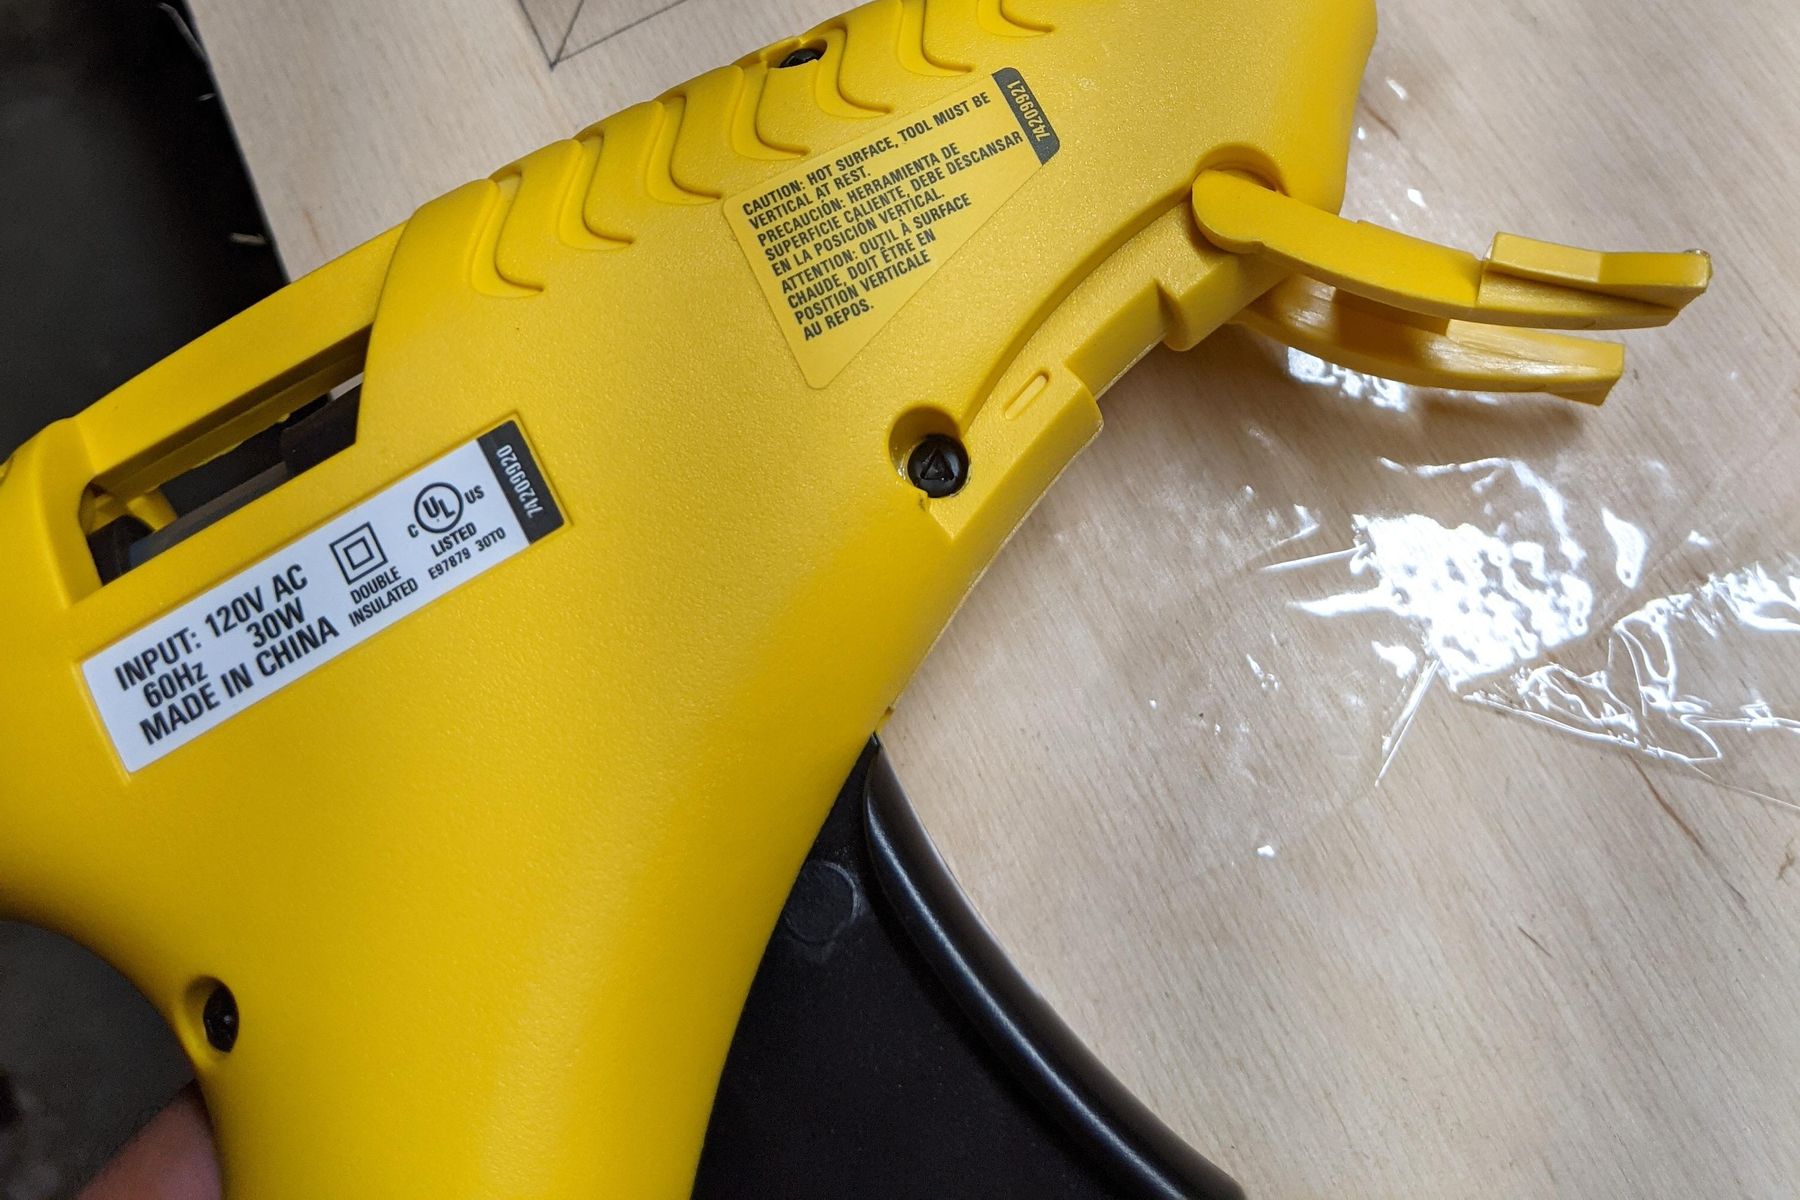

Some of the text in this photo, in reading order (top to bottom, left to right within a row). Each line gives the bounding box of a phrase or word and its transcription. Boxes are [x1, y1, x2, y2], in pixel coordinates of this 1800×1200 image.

[1007, 80, 1051, 142] 74209921
[743, 91, 991, 215] CAUTION: HOT SURFACE, TOOL MUST BE
[749, 166, 871, 229] VERTICAL AT REST.
[757, 142, 960, 247] PRECAUCIÓN: HERRAMIENTA DE
[765, 131, 1023, 261] SUPERFICIE CALIENTE, DEBE DESCANSAR
[771, 257, 792, 276] EN
[793, 250, 812, 266] LA
[878, 188, 945, 224] VERTICAL.
[781, 193, 972, 294] ATTENTION: OUTIL À SURFACE
[788, 228, 936, 309] CHAUDE, DOIT ÊTRE EN
[795, 249, 931, 324] POSITION VERTICALE
[803, 298, 874, 341] AU REPOS.
[422, 496, 456, 519] UL
[464, 485, 485, 504] US
[431, 522, 477, 556] LISTED
[348, 577, 419, 627] INSULATED
[350, 565, 401, 604] DOUBLE
[428, 547, 471, 580] E97879
[114, 563, 308, 691] INPUT: 120V AC
[142, 597, 305, 708] 60Hz 30W
[139, 616, 340, 745] MADE IN CHINA
